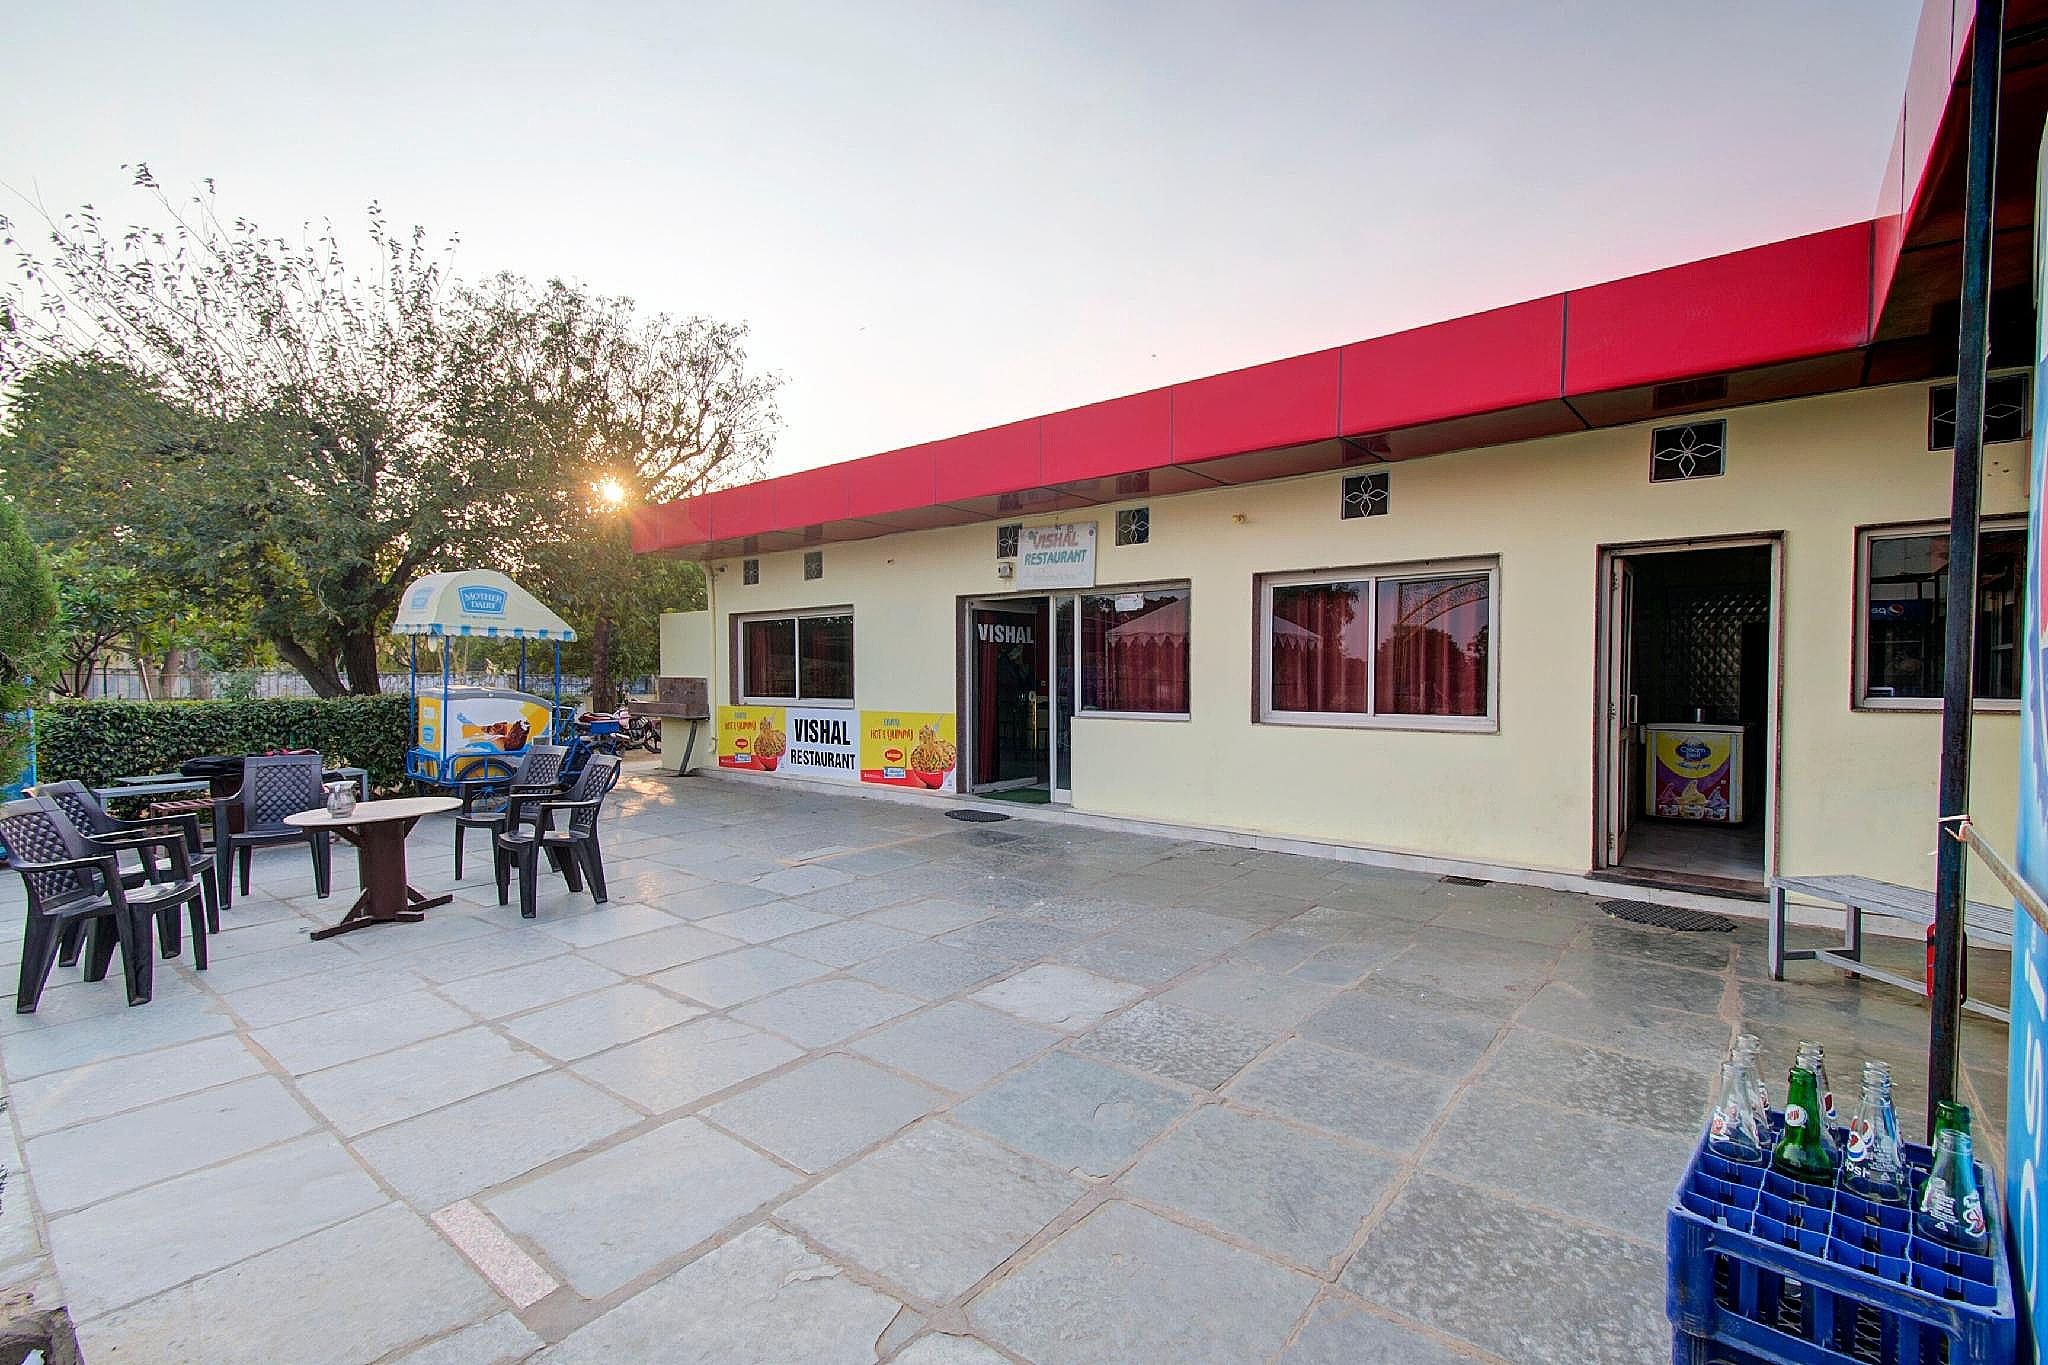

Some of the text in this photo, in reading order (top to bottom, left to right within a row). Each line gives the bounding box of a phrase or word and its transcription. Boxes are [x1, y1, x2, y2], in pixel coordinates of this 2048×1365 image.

[1033, 530, 1079, 549] VISHAL
[1024, 549, 1088, 567] RESTAURANT
[977, 623, 1034, 644] VISHAL
[794, 719, 851, 745] VISHAL
[790, 749, 855, 770] RESTAURANT
